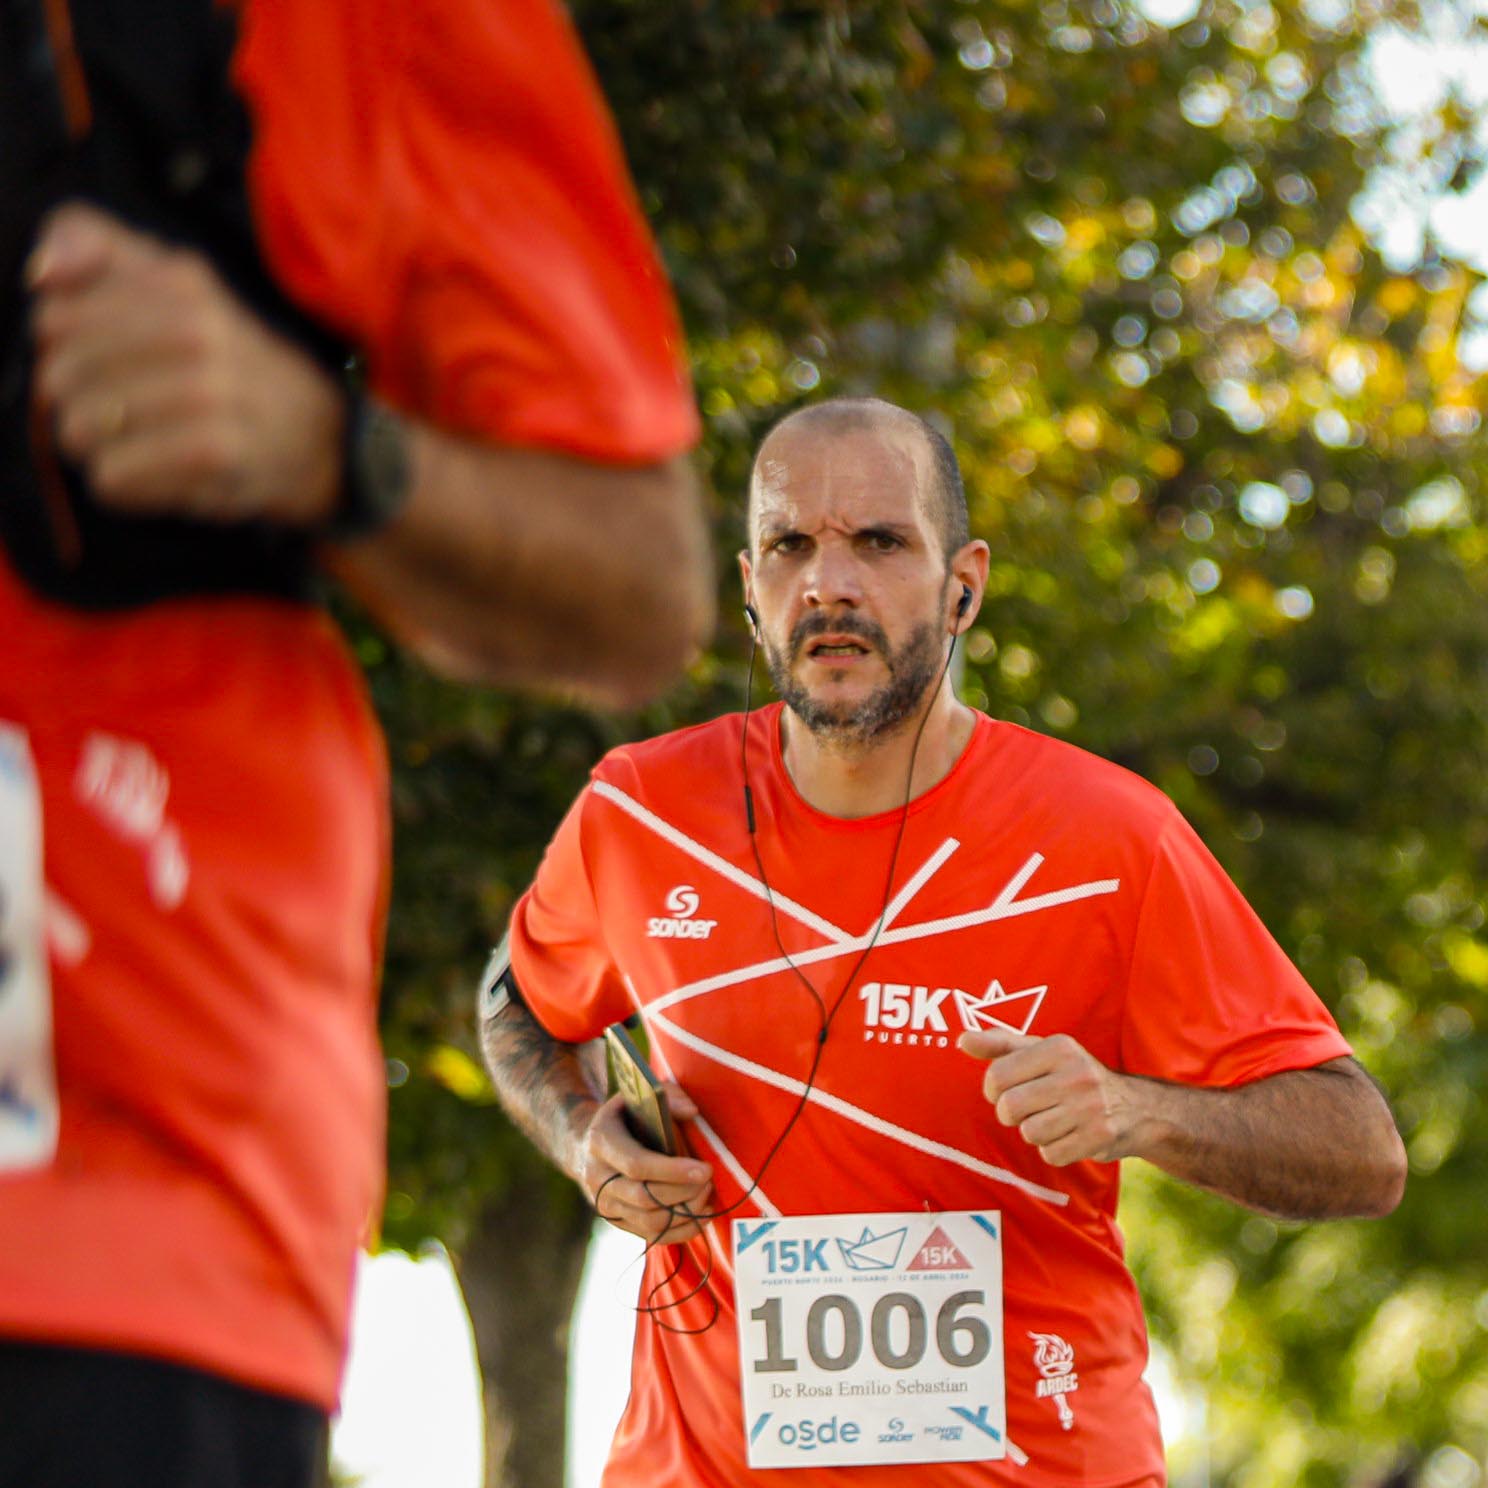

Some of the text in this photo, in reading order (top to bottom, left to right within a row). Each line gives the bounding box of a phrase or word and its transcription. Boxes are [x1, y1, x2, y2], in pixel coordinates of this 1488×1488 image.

[858, 982, 950, 1032] 15K
[864, 1032, 948, 1048] PUERTO
[761, 1239, 830, 1272] 15K
[921, 1248, 957, 1265] 15K
[751, 1291, 991, 1372] 1006
[772, 1377, 967, 1398] De Rosa Emilio Sebastian
[779, 1416, 860, 1450] osde
